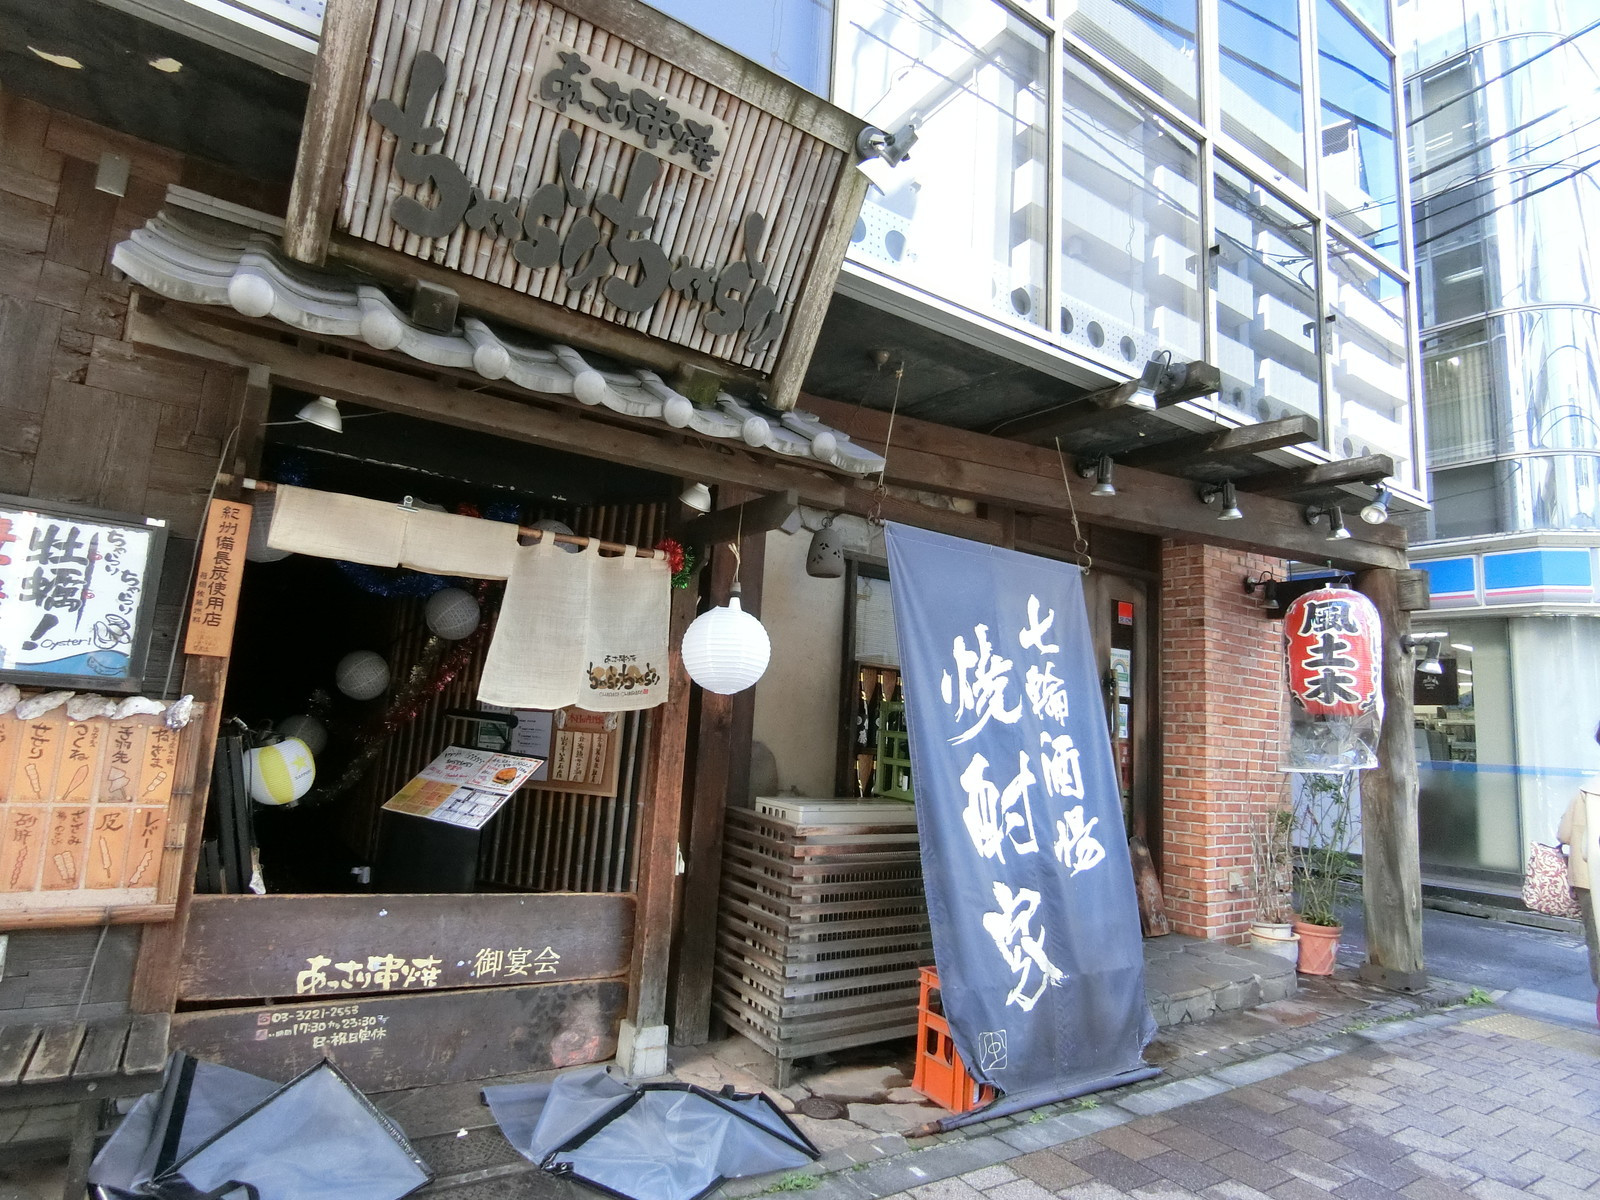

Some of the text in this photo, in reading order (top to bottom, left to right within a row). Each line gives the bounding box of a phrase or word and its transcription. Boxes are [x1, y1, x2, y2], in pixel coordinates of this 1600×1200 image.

[202, 505, 241, 628] 紀州備長炭使用店
[28, 721, 53, 759] せせり
[69, 723, 90, 761] つくね
[111, 725, 134, 764] 手羽先
[1019, 593, 1106, 878] 七輪酒場
[13, 812, 38, 845] 砂肝
[67, 809, 86, 846] ささみ
[95, 812, 124, 832] 皮
[141, 811, 160, 848] レバー
[474, 946, 561, 978] 御宴会
[271, 1005, 360, 1023] 03-3221-2553
